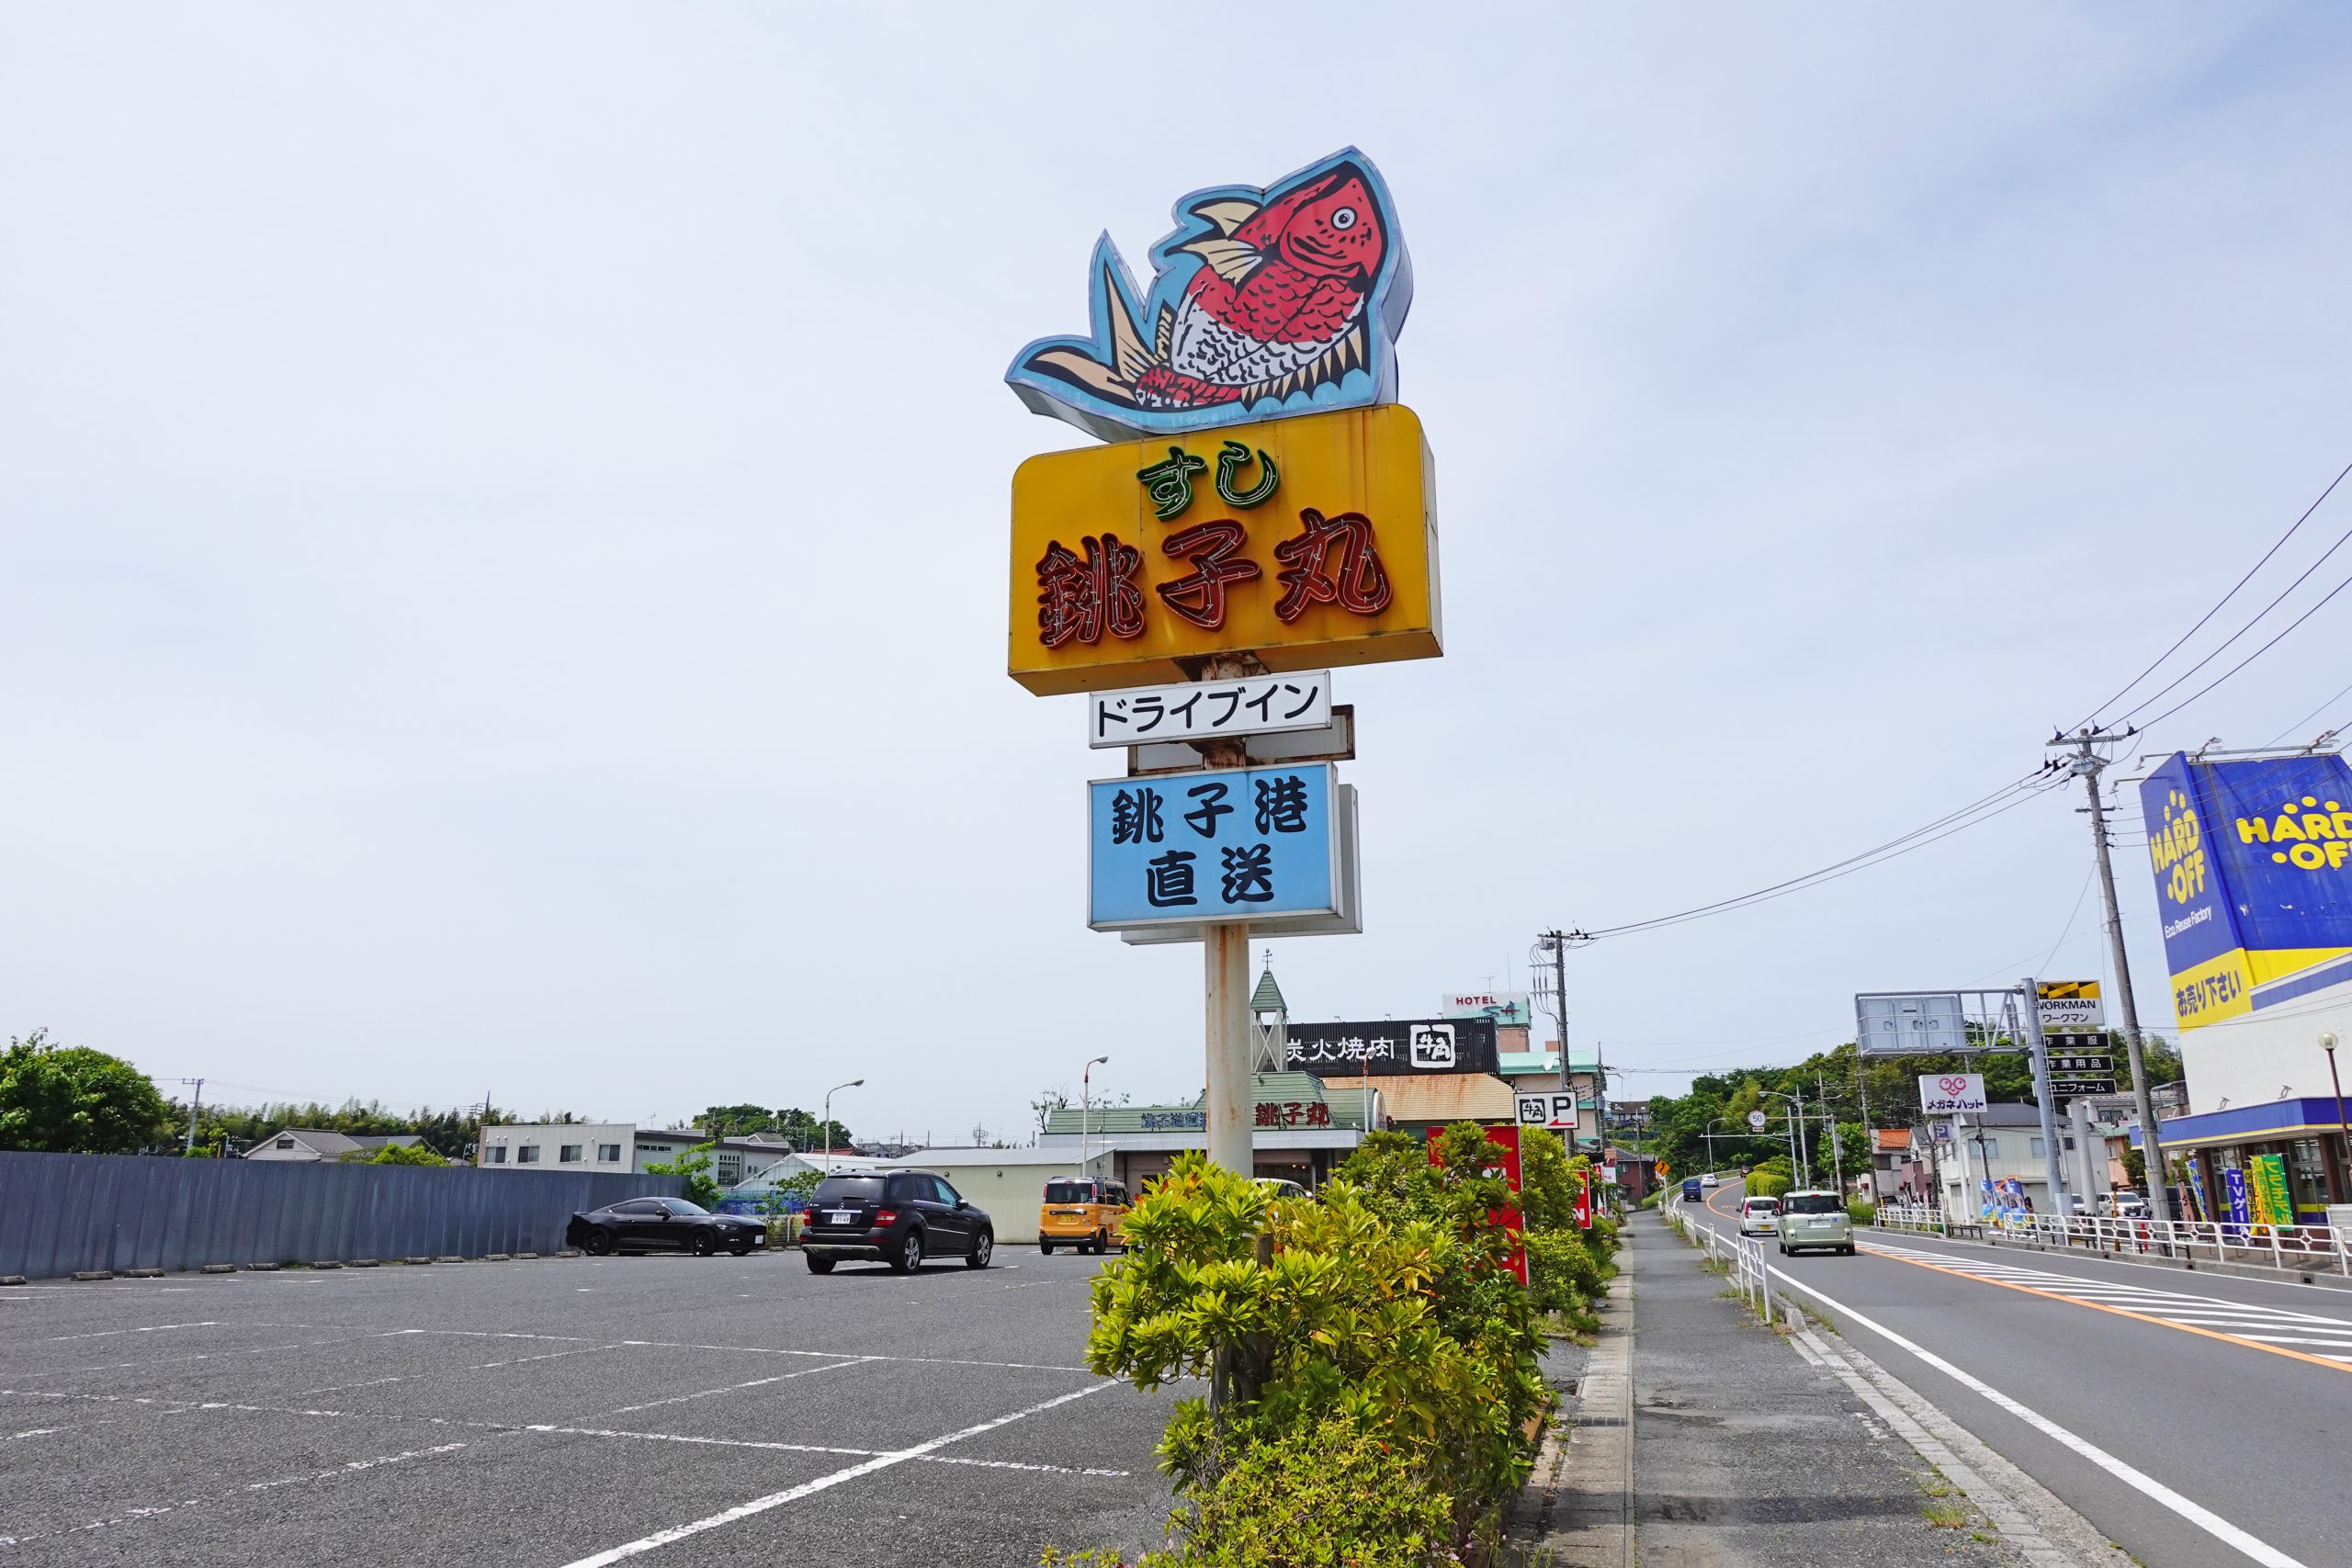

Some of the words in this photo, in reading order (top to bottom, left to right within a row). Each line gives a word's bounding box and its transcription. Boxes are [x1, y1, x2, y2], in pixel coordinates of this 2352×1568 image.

[1035, 507, 1393, 649] 銚子丸
[1099, 684, 1318, 738] ドライブイン
[1112, 775, 1308, 844] 銚子港
[2149, 808, 2200, 874] HARD
[2235, 812, 2352, 843] HARD
[2289, 841, 2352, 870] OF
[1146, 842, 1274, 908] 直送
[2172, 850, 2205, 904] OFF
[2190, 906, 2211, 926] Factory
[1455, 996, 1497, 1006] HOTEL
[2036, 999, 2097, 1010] WORKMAN
[2176, 970, 2242, 1018] お売り下さい
[2042, 1013, 2089, 1023] ワークマン
[1286, 1036, 1395, 1062] 炭火焼肉
[1415, 1032, 1453, 1062] 牛角
[2051, 1082, 2107, 1093] ユニフォーム
[1255, 1101, 1331, 1127] 銚子丸
[1522, 1102, 1544, 1119] 牛角
[1552, 1096, 1572, 1117] P
[1752, 1114, 1763, 1122] 50
[1927, 1099, 1984, 1110] メガネハット
